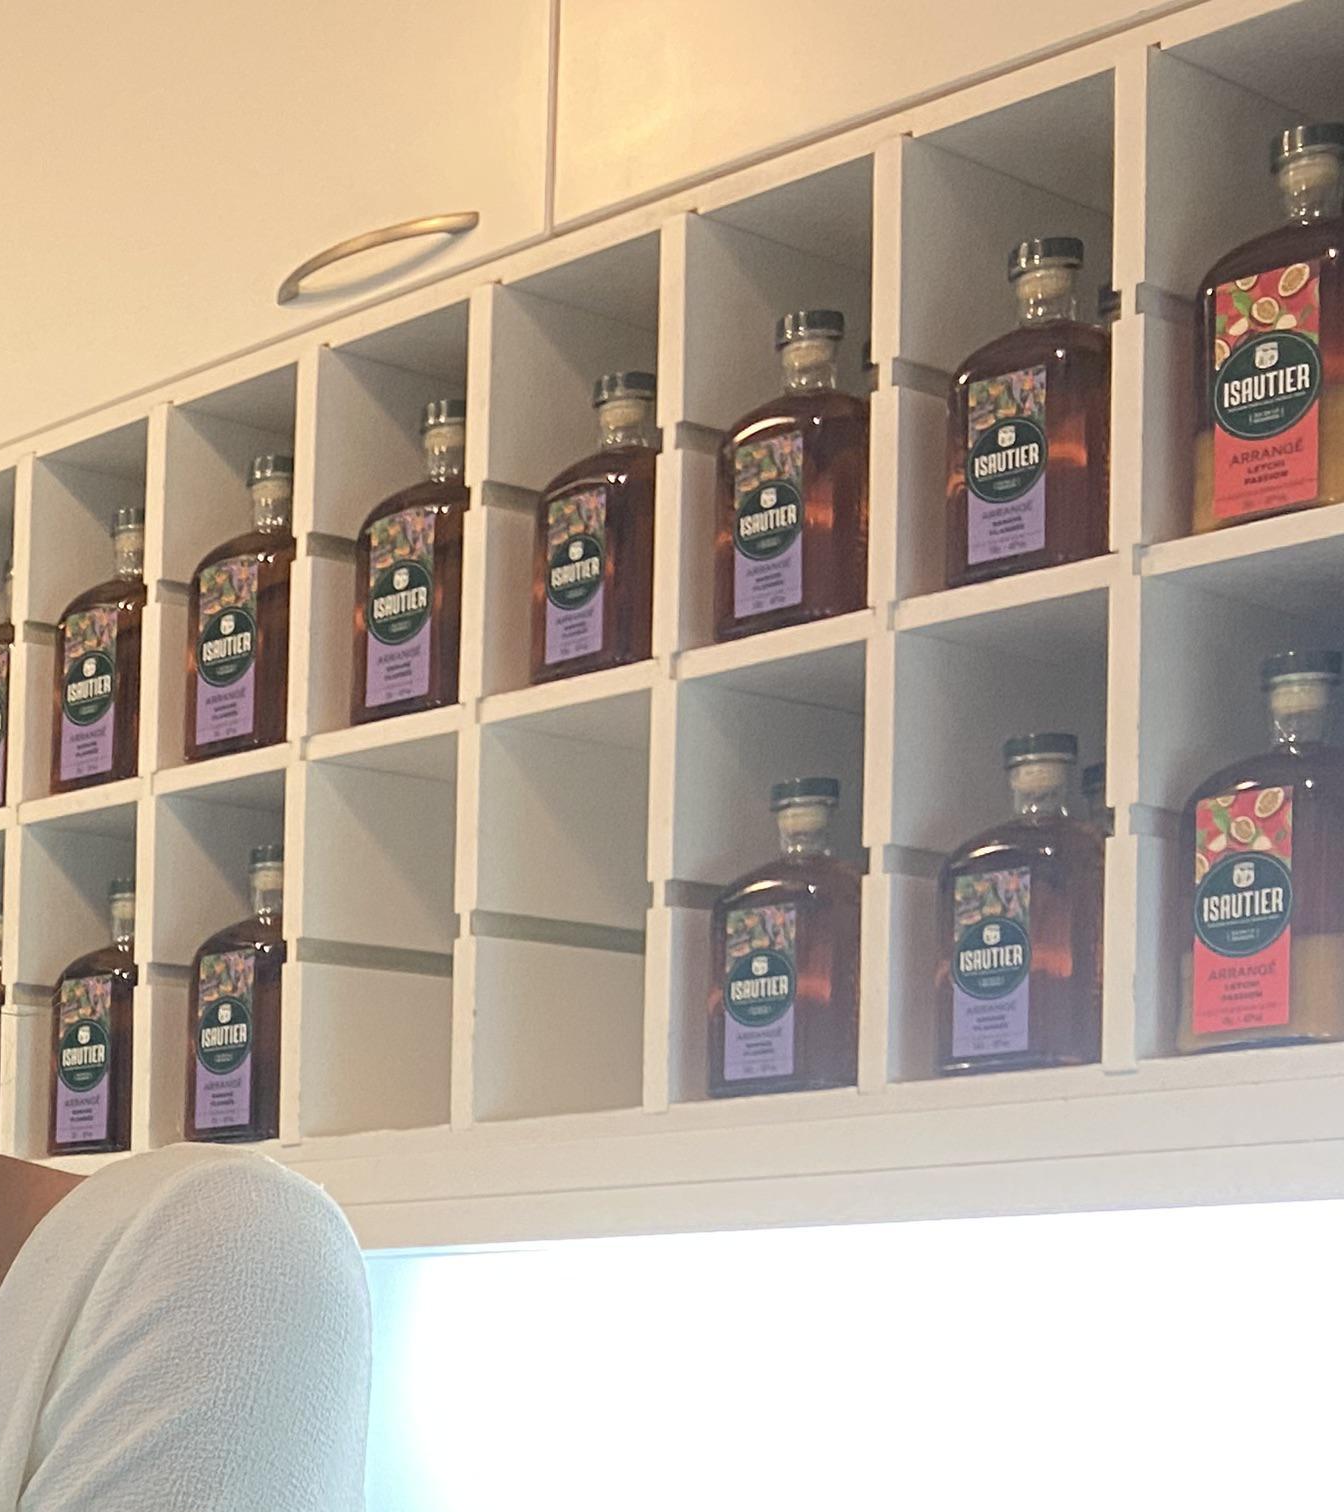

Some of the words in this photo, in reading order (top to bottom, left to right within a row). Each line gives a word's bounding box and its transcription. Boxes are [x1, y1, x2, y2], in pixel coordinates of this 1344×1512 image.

[1223, 363, 1310, 408] ISAUTIER
[974, 442, 1039, 478] ISAUTIER
[740, 503, 797, 537] ISAUTIER
[373, 586, 428, 620] ISAUTIER
[202, 631, 251, 662] ISAUTIER
[67, 674, 111, 703] ISAUTIER
[1203, 887, 1284, 922] ISAUTIER
[959, 944, 1023, 972] ISAUTIER
[731, 975, 788, 1001] ISAUTIER
[200, 1023, 248, 1049] ISAUTIER
[62, 1042, 106, 1069] ISAUTIER
